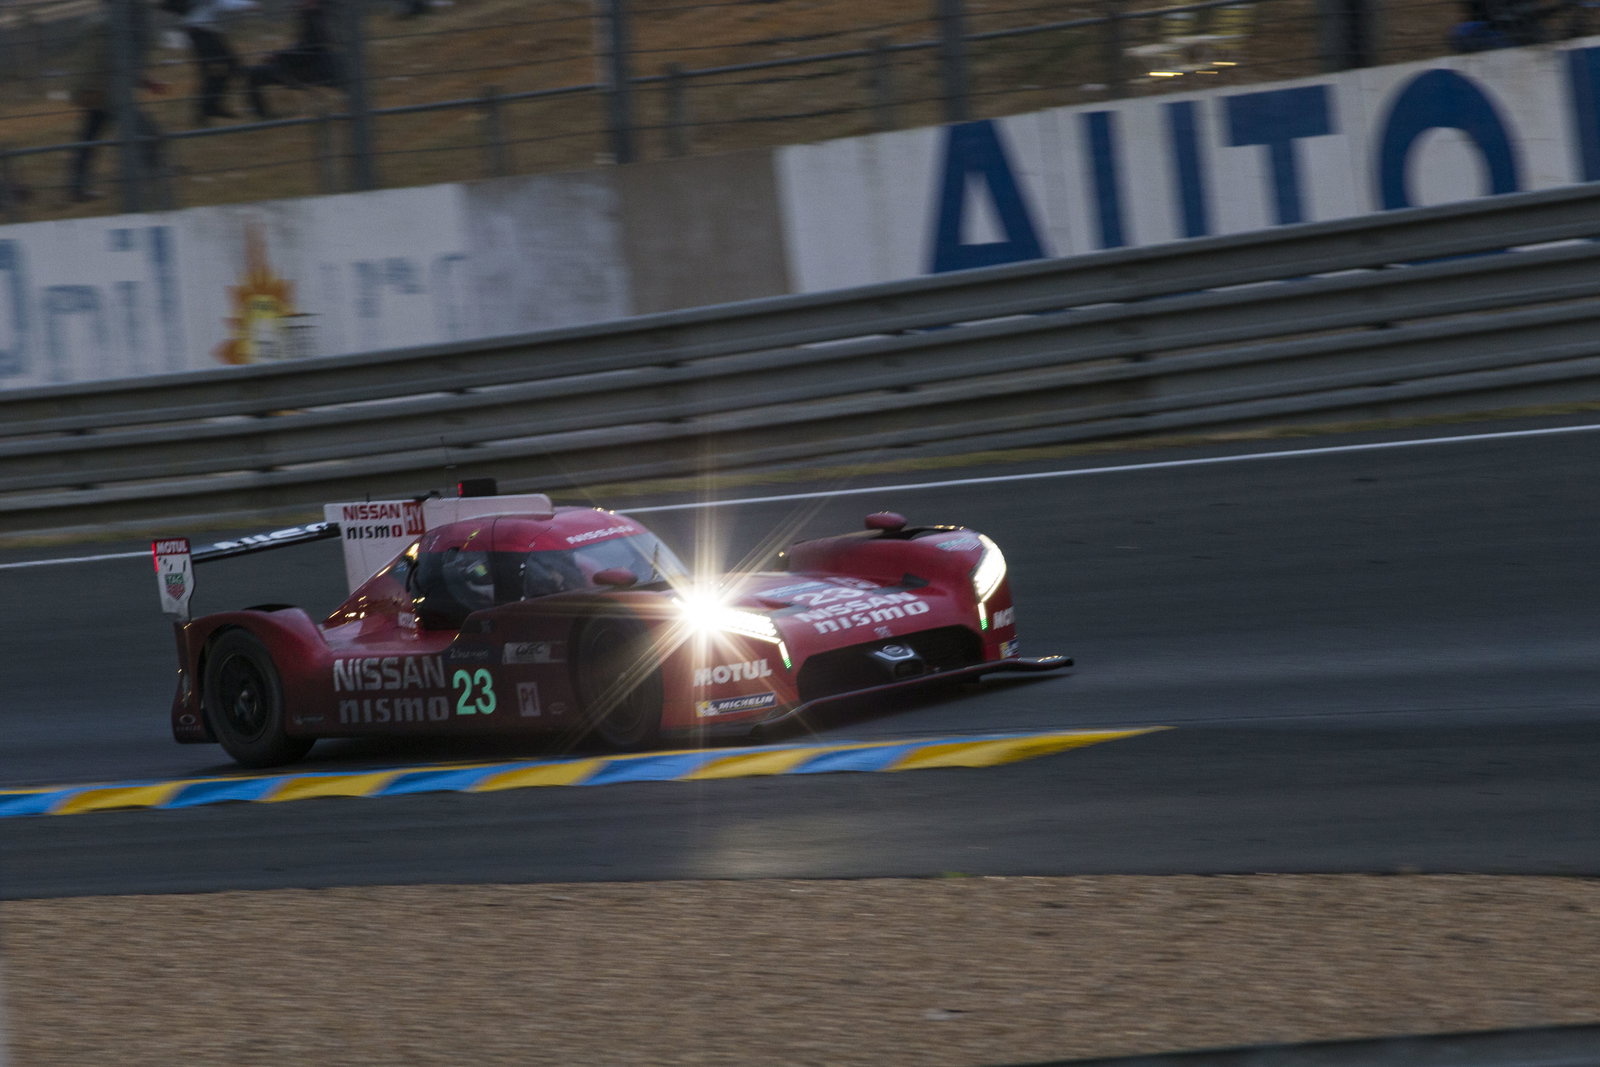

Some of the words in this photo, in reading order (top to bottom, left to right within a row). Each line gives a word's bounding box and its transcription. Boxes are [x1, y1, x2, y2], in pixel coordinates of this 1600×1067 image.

[343, 504, 400, 521] NISSAN
[347, 525, 402, 539] nismo
[156, 541, 188, 553] MOTUL
[794, 592, 919, 623] NISSAN
[813, 601, 930, 634] nismo
[333, 656, 446, 692] NISSAN
[693, 659, 772, 687] MOTUL
[453, 668, 497, 715] 23
[718, 695, 775, 710] MICHELIN
[339, 696, 450, 724] nismo
